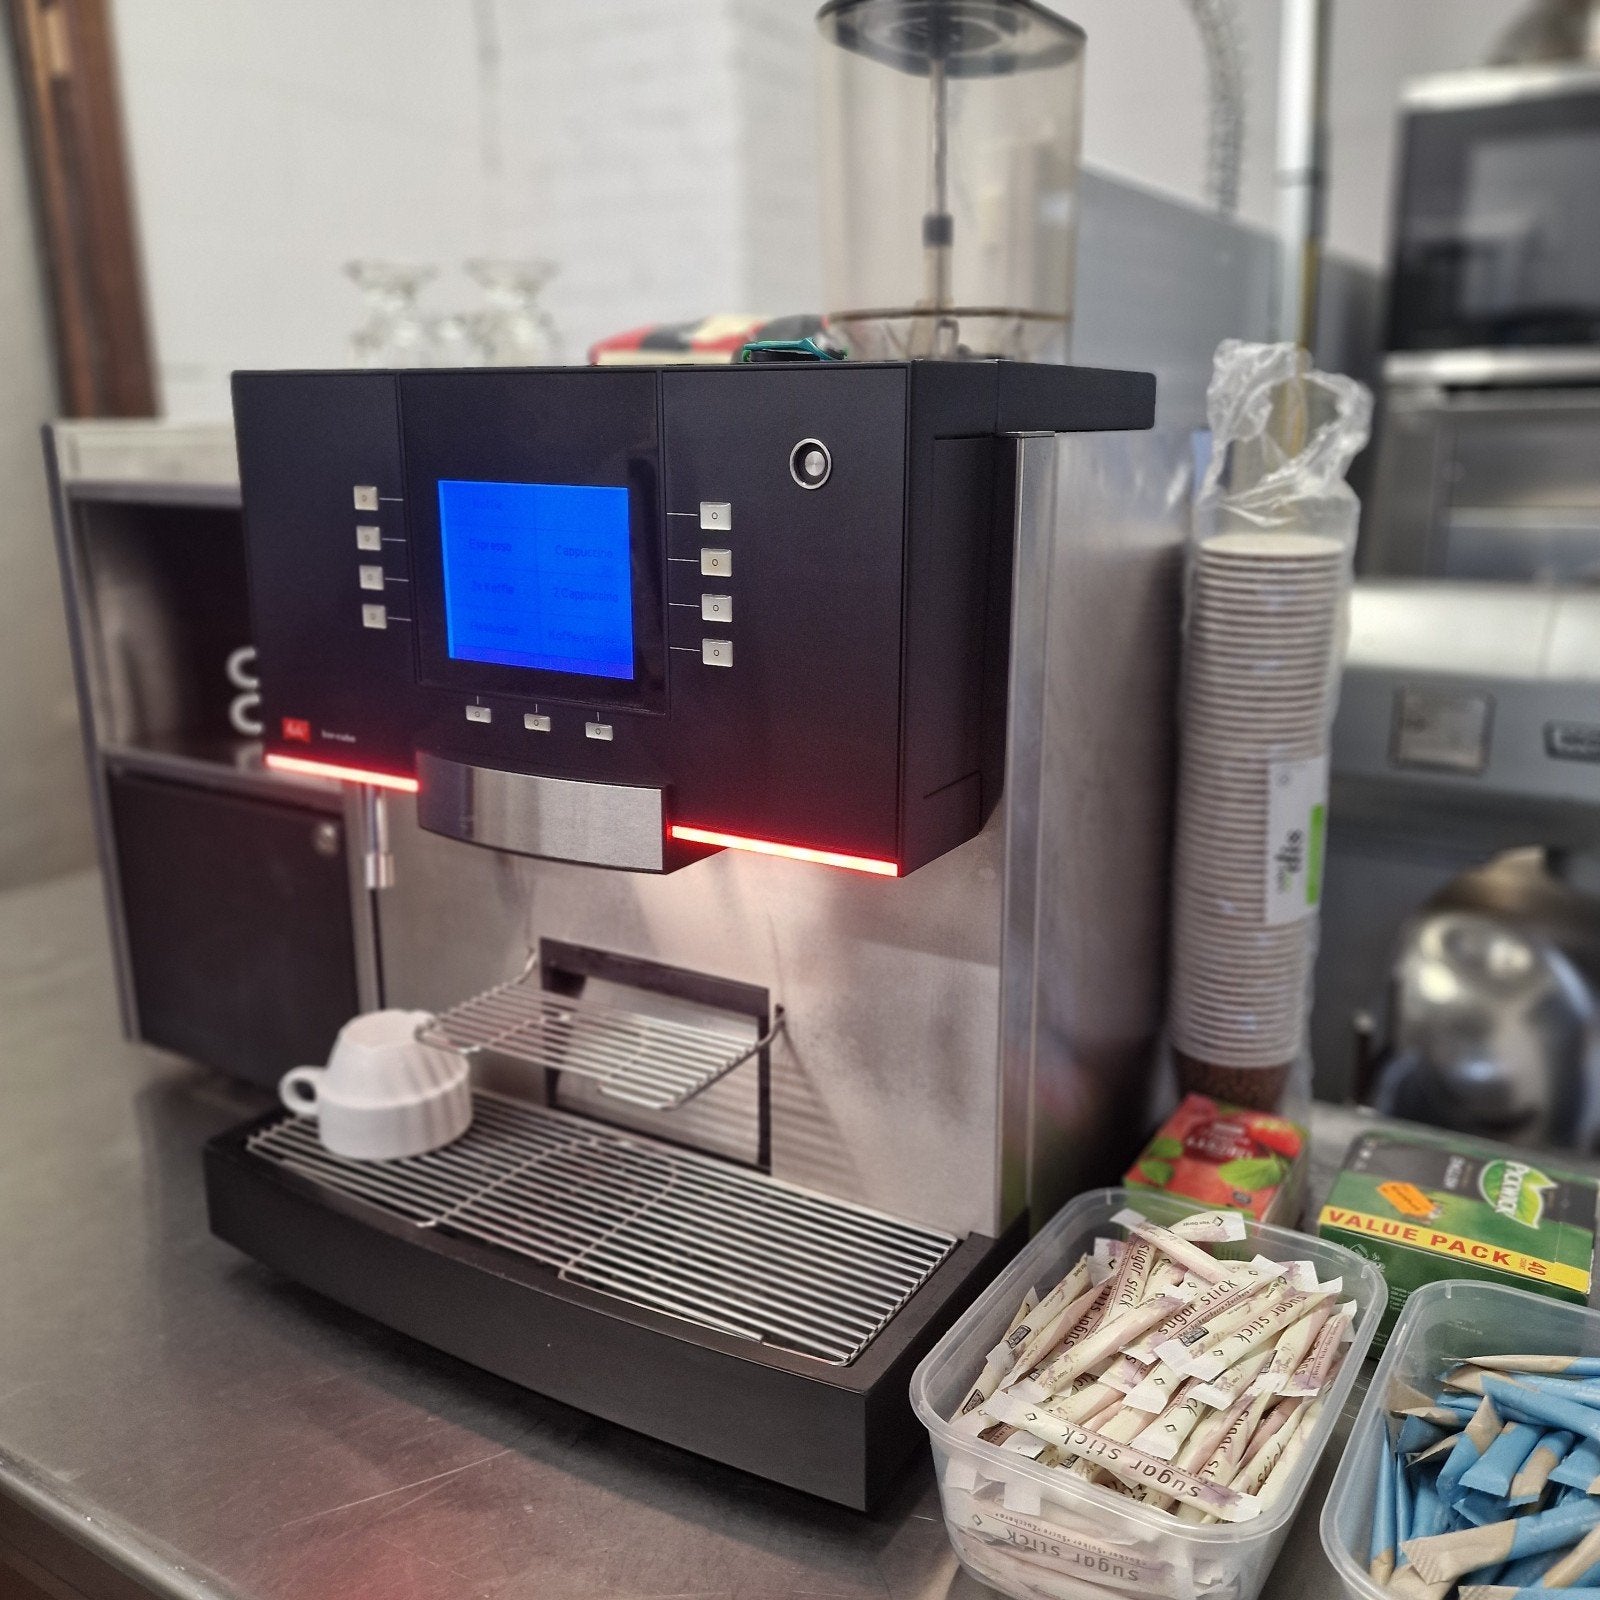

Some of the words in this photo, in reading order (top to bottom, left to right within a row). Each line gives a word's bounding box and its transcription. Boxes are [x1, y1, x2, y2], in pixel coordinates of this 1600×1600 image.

[555, 544, 613, 559] Cappuccino
[1328, 1209, 1418, 1241] VALUE
[1430, 1234, 1511, 1266] PACK
[1131, 1244, 1150, 1274] sugar
[1527, 1261, 1547, 1277] 40
[1119, 1278, 1138, 1308] stick
[1158, 1303, 1198, 1335] sugar
[1200, 1279, 1238, 1306] stick
[1271, 1295, 1307, 1317] sugar
[1064, 1315, 1093, 1347] sugar
[1091, 1284, 1113, 1312] stick
[1234, 1315, 1270, 1343] stick
[1060, 1426, 1122, 1460] stick
[1129, 1459, 1202, 1498] sugar
[1006, 1528, 1061, 1557] stick
[1073, 1553, 1139, 1582] sugar
